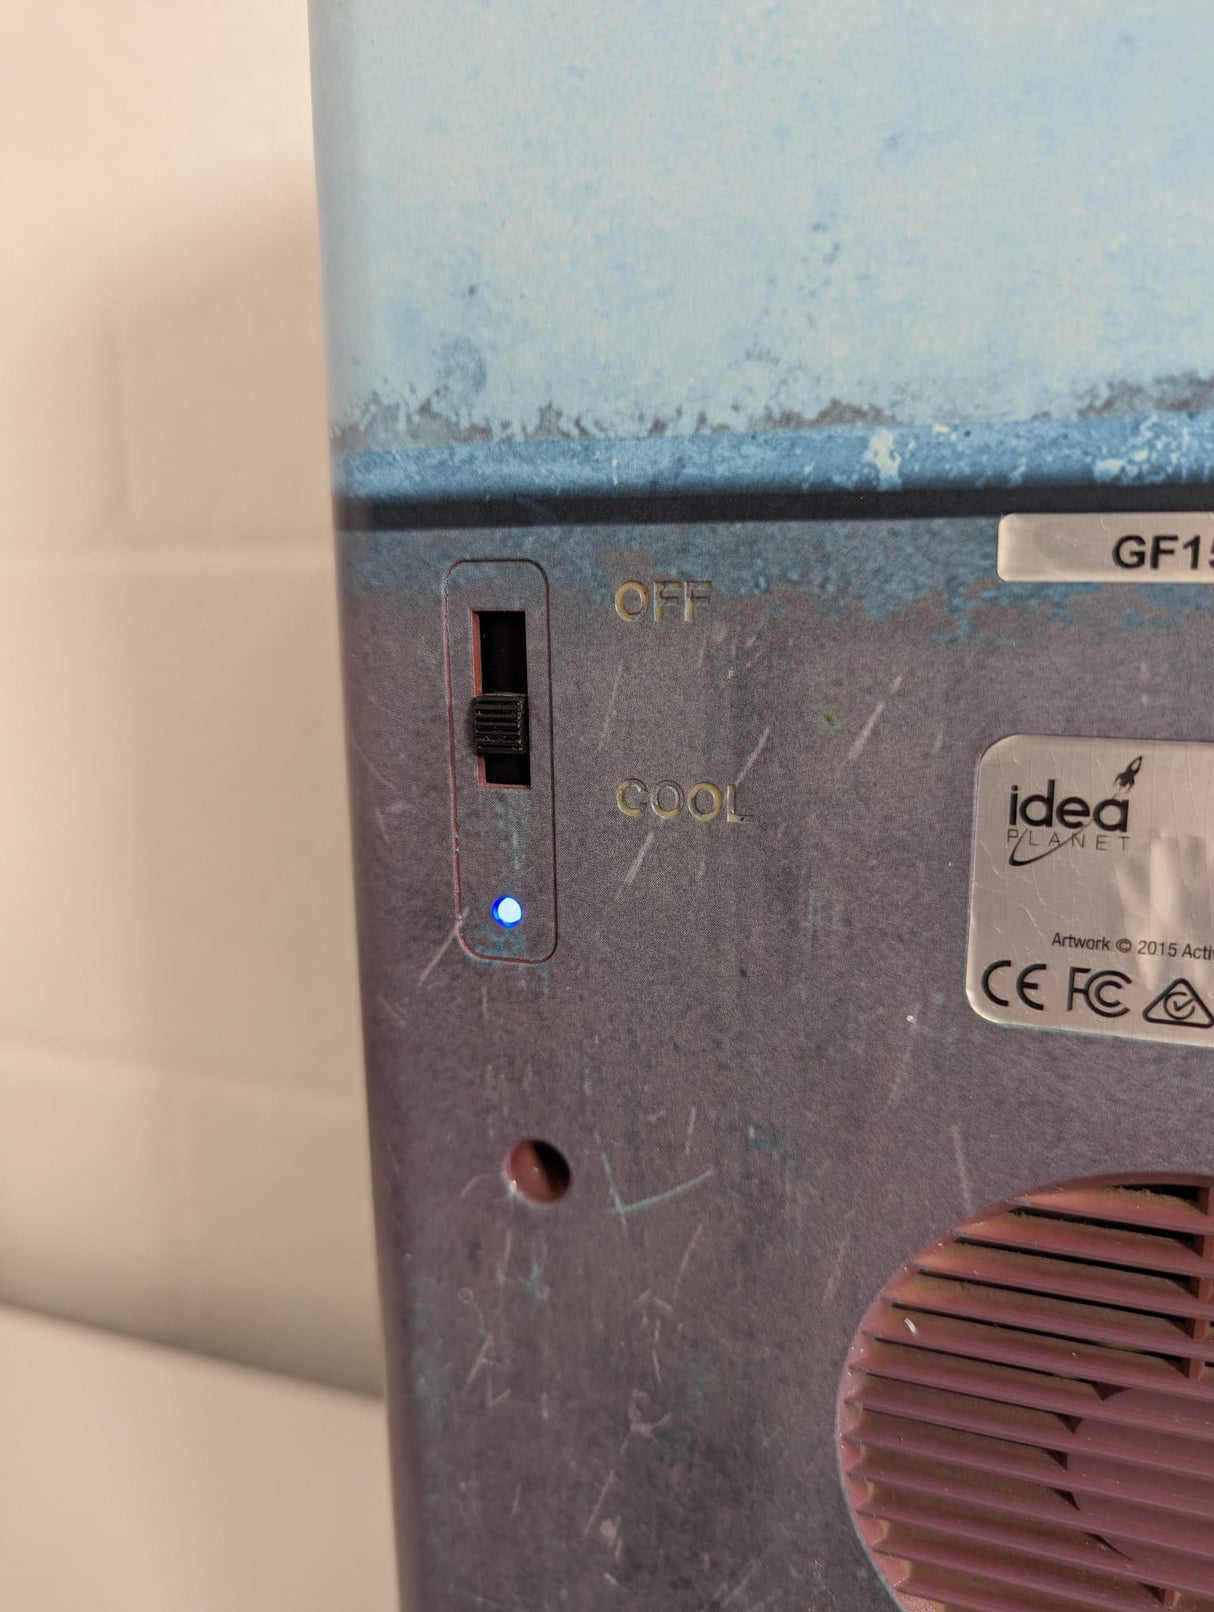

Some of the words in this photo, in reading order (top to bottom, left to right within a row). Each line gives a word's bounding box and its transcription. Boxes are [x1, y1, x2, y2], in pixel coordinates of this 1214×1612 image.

[1112, 534, 1214, 570] GF1
[615, 580, 712, 622] OFF
[616, 778, 753, 824] COOL
[1008, 779, 1129, 833] idea
[1007, 828, 1131, 851] PLANET
[1051, 932, 1111, 952] Artwork
[1137, 940, 1177, 957] 2015
[1181, 945, 1214, 961] Acti
[981, 960, 1047, 1011] CE
